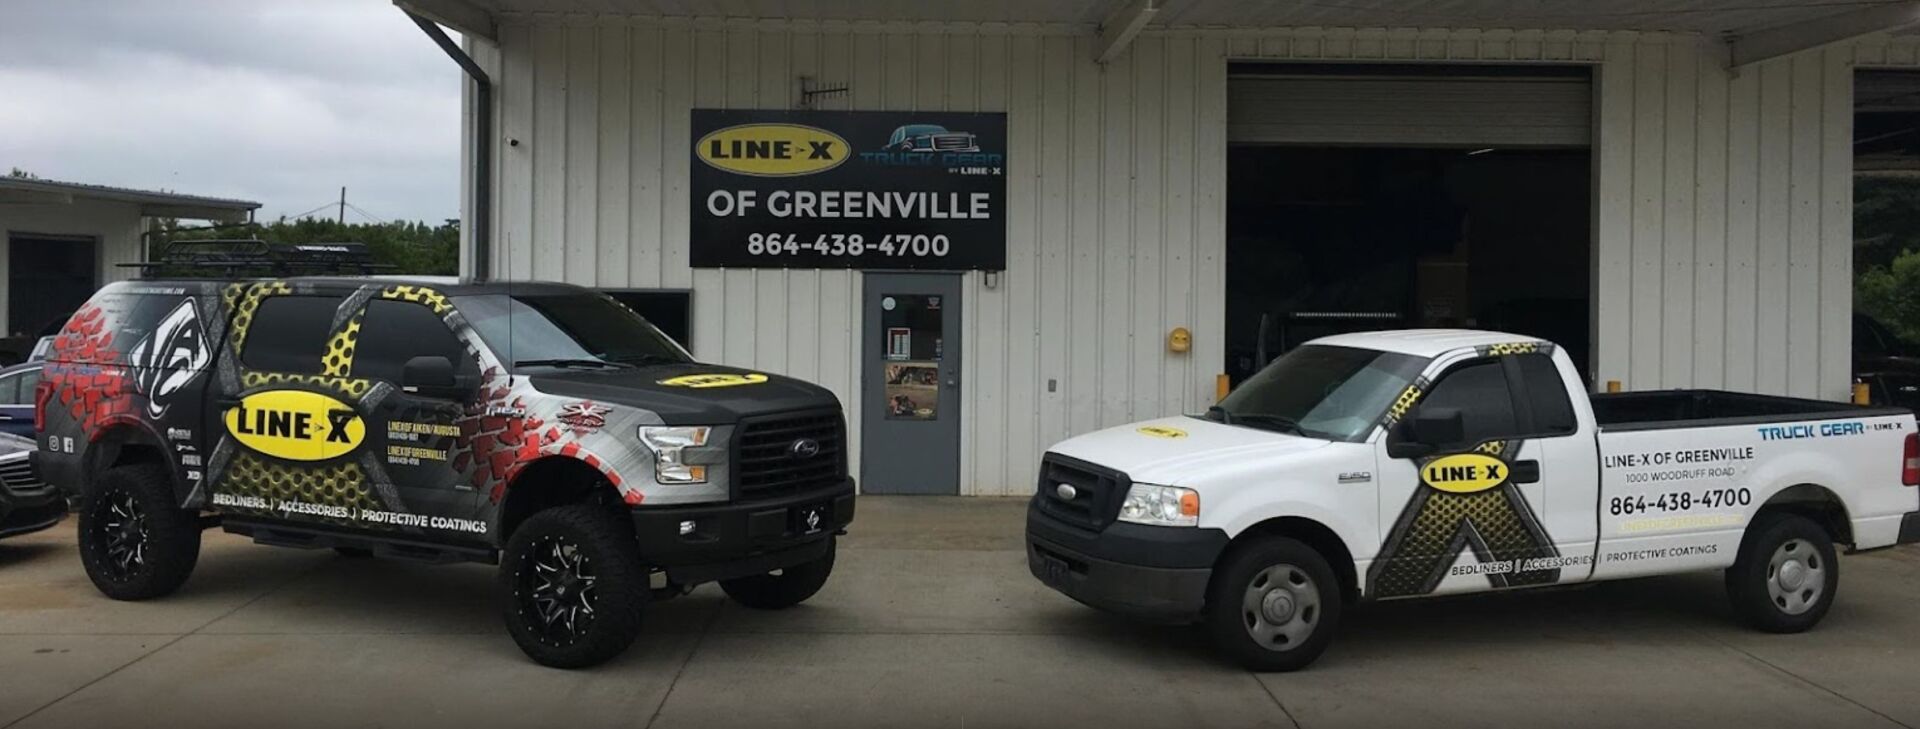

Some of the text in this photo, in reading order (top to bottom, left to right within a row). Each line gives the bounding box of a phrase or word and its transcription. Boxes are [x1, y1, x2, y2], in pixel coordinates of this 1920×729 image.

[860, 152, 1002, 166] TRUCK GEAR
[707, 190, 990, 219] OF GREENVILLE
[747, 233, 950, 256] 864-438-4700
[1757, 424, 1815, 441] TRUCK
[1820, 422, 1864, 436] GEAR
[1605, 447, 1754, 468] LINE-X OF GREENVILLE
[1626, 467, 1735, 483] 1000 WOODRUFF ROAD
[213, 493, 487, 533] BEDLINERS ACCESSORIES PROTECTIVE COATINGS
[1610, 487, 1751, 516] 864-438-4700
[1451, 544, 1717, 576] BEDLINERS ACCESSORIES PROTECTIVE COATINGS
